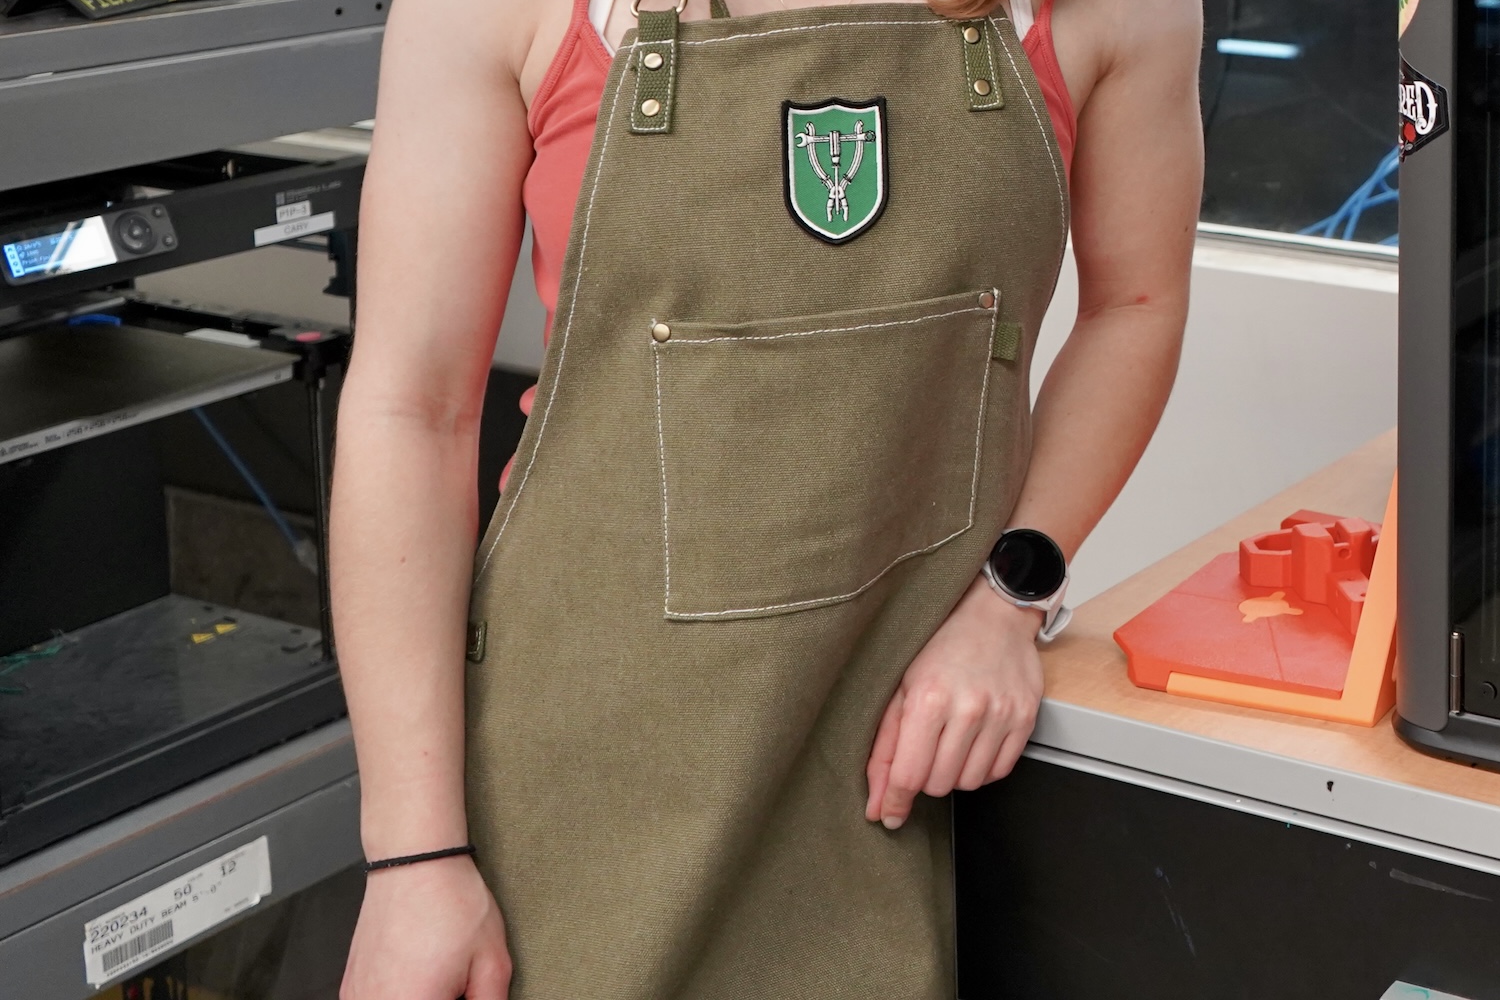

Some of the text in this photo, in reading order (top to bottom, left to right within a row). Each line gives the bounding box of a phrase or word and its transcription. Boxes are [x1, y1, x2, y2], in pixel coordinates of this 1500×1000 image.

[220, 860, 237, 877] 12
[174, 883, 192, 900] 50
[90, 906, 148, 943] 220234
[91, 932, 124, 955] HEAVY
[129, 917, 156, 936] DUTY
[161, 901, 188, 918] BEAM
